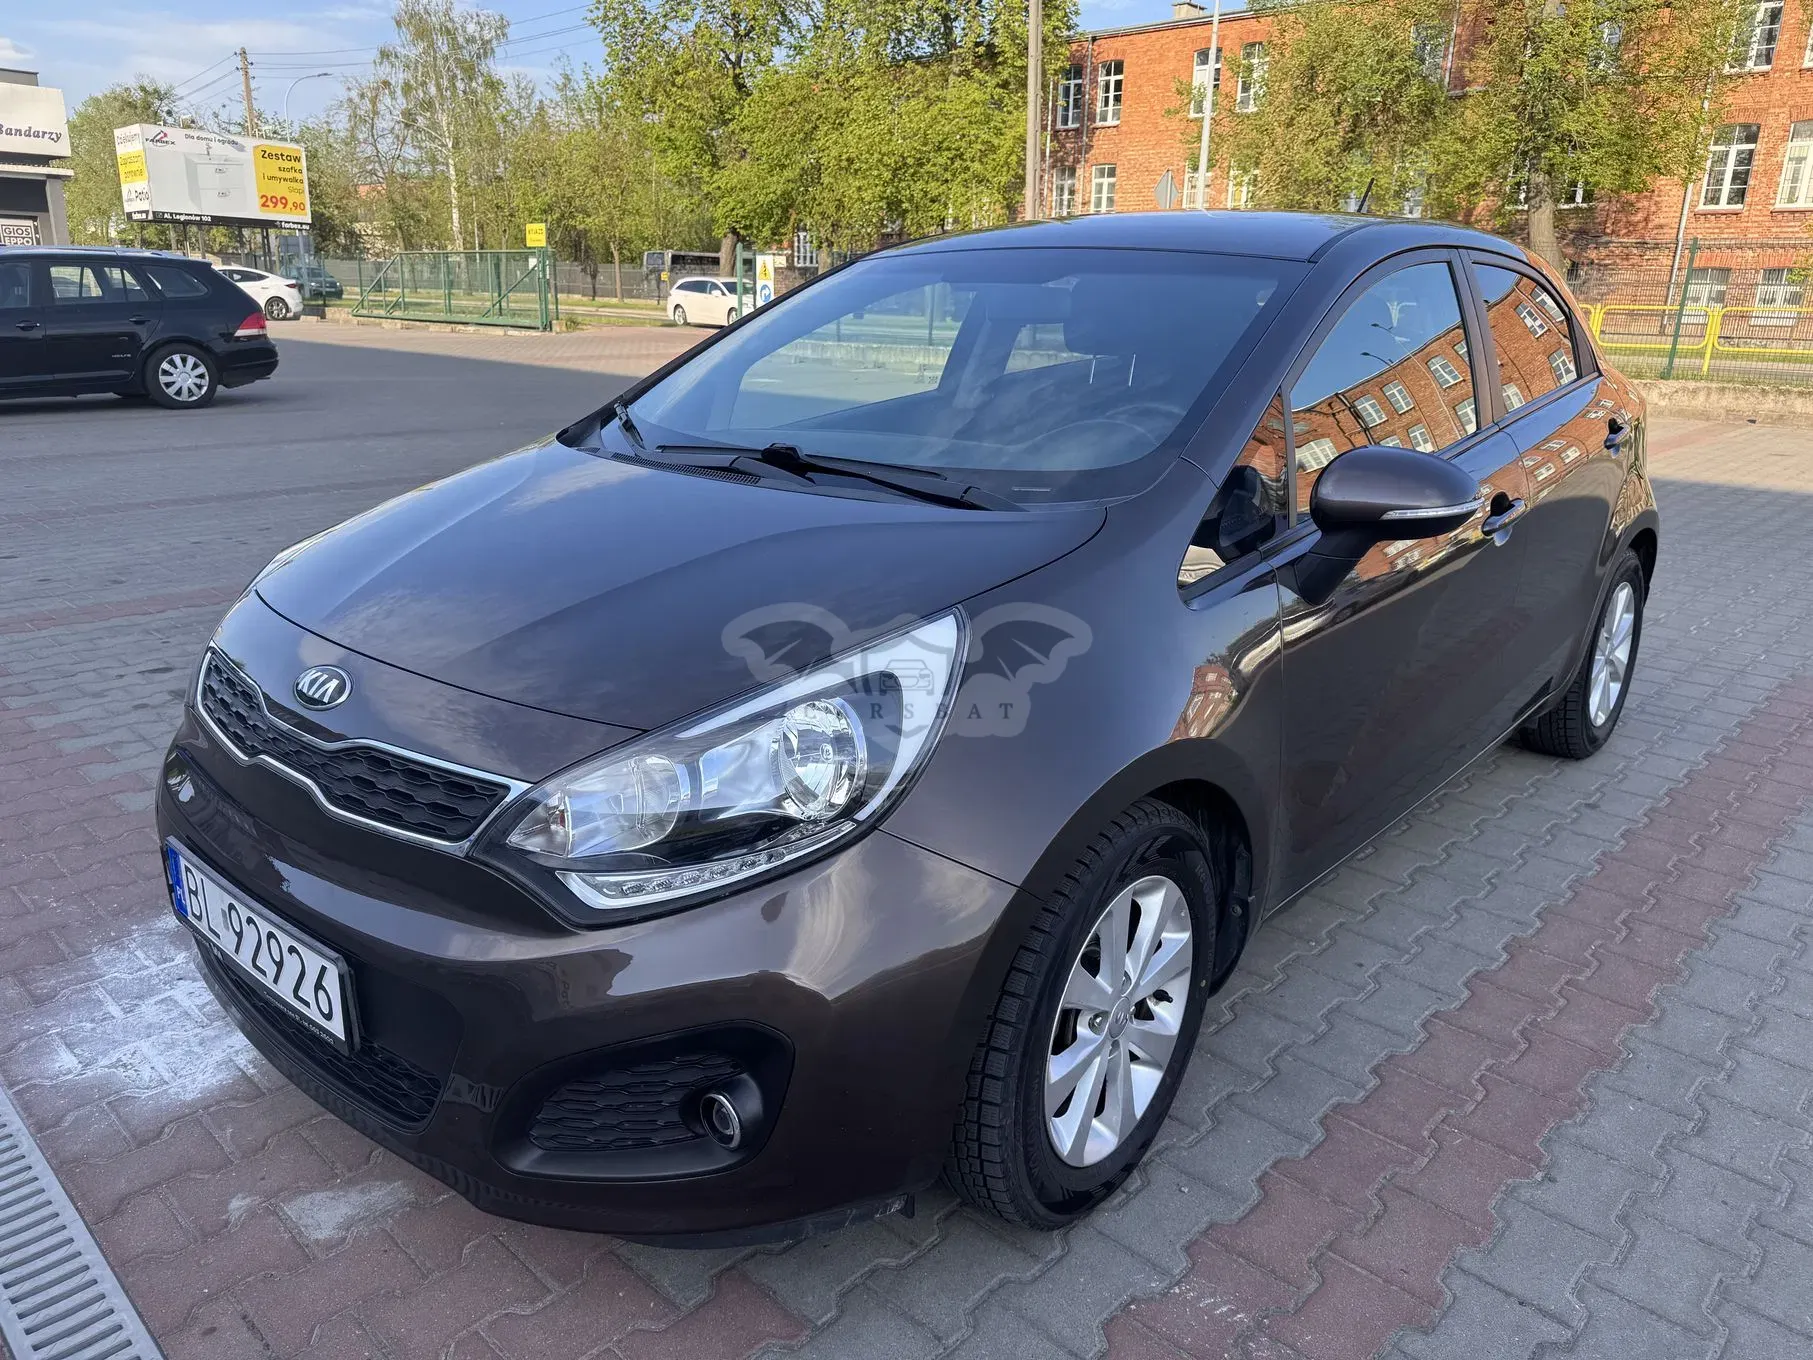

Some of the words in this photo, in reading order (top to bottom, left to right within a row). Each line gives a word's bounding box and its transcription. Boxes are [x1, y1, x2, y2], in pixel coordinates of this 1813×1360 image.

[260, 149, 301, 163] Zestaw
[3, 227, 31, 236] GIOS
[184, 863, 222, 940] BL
[227, 902, 334, 1022] 92926
